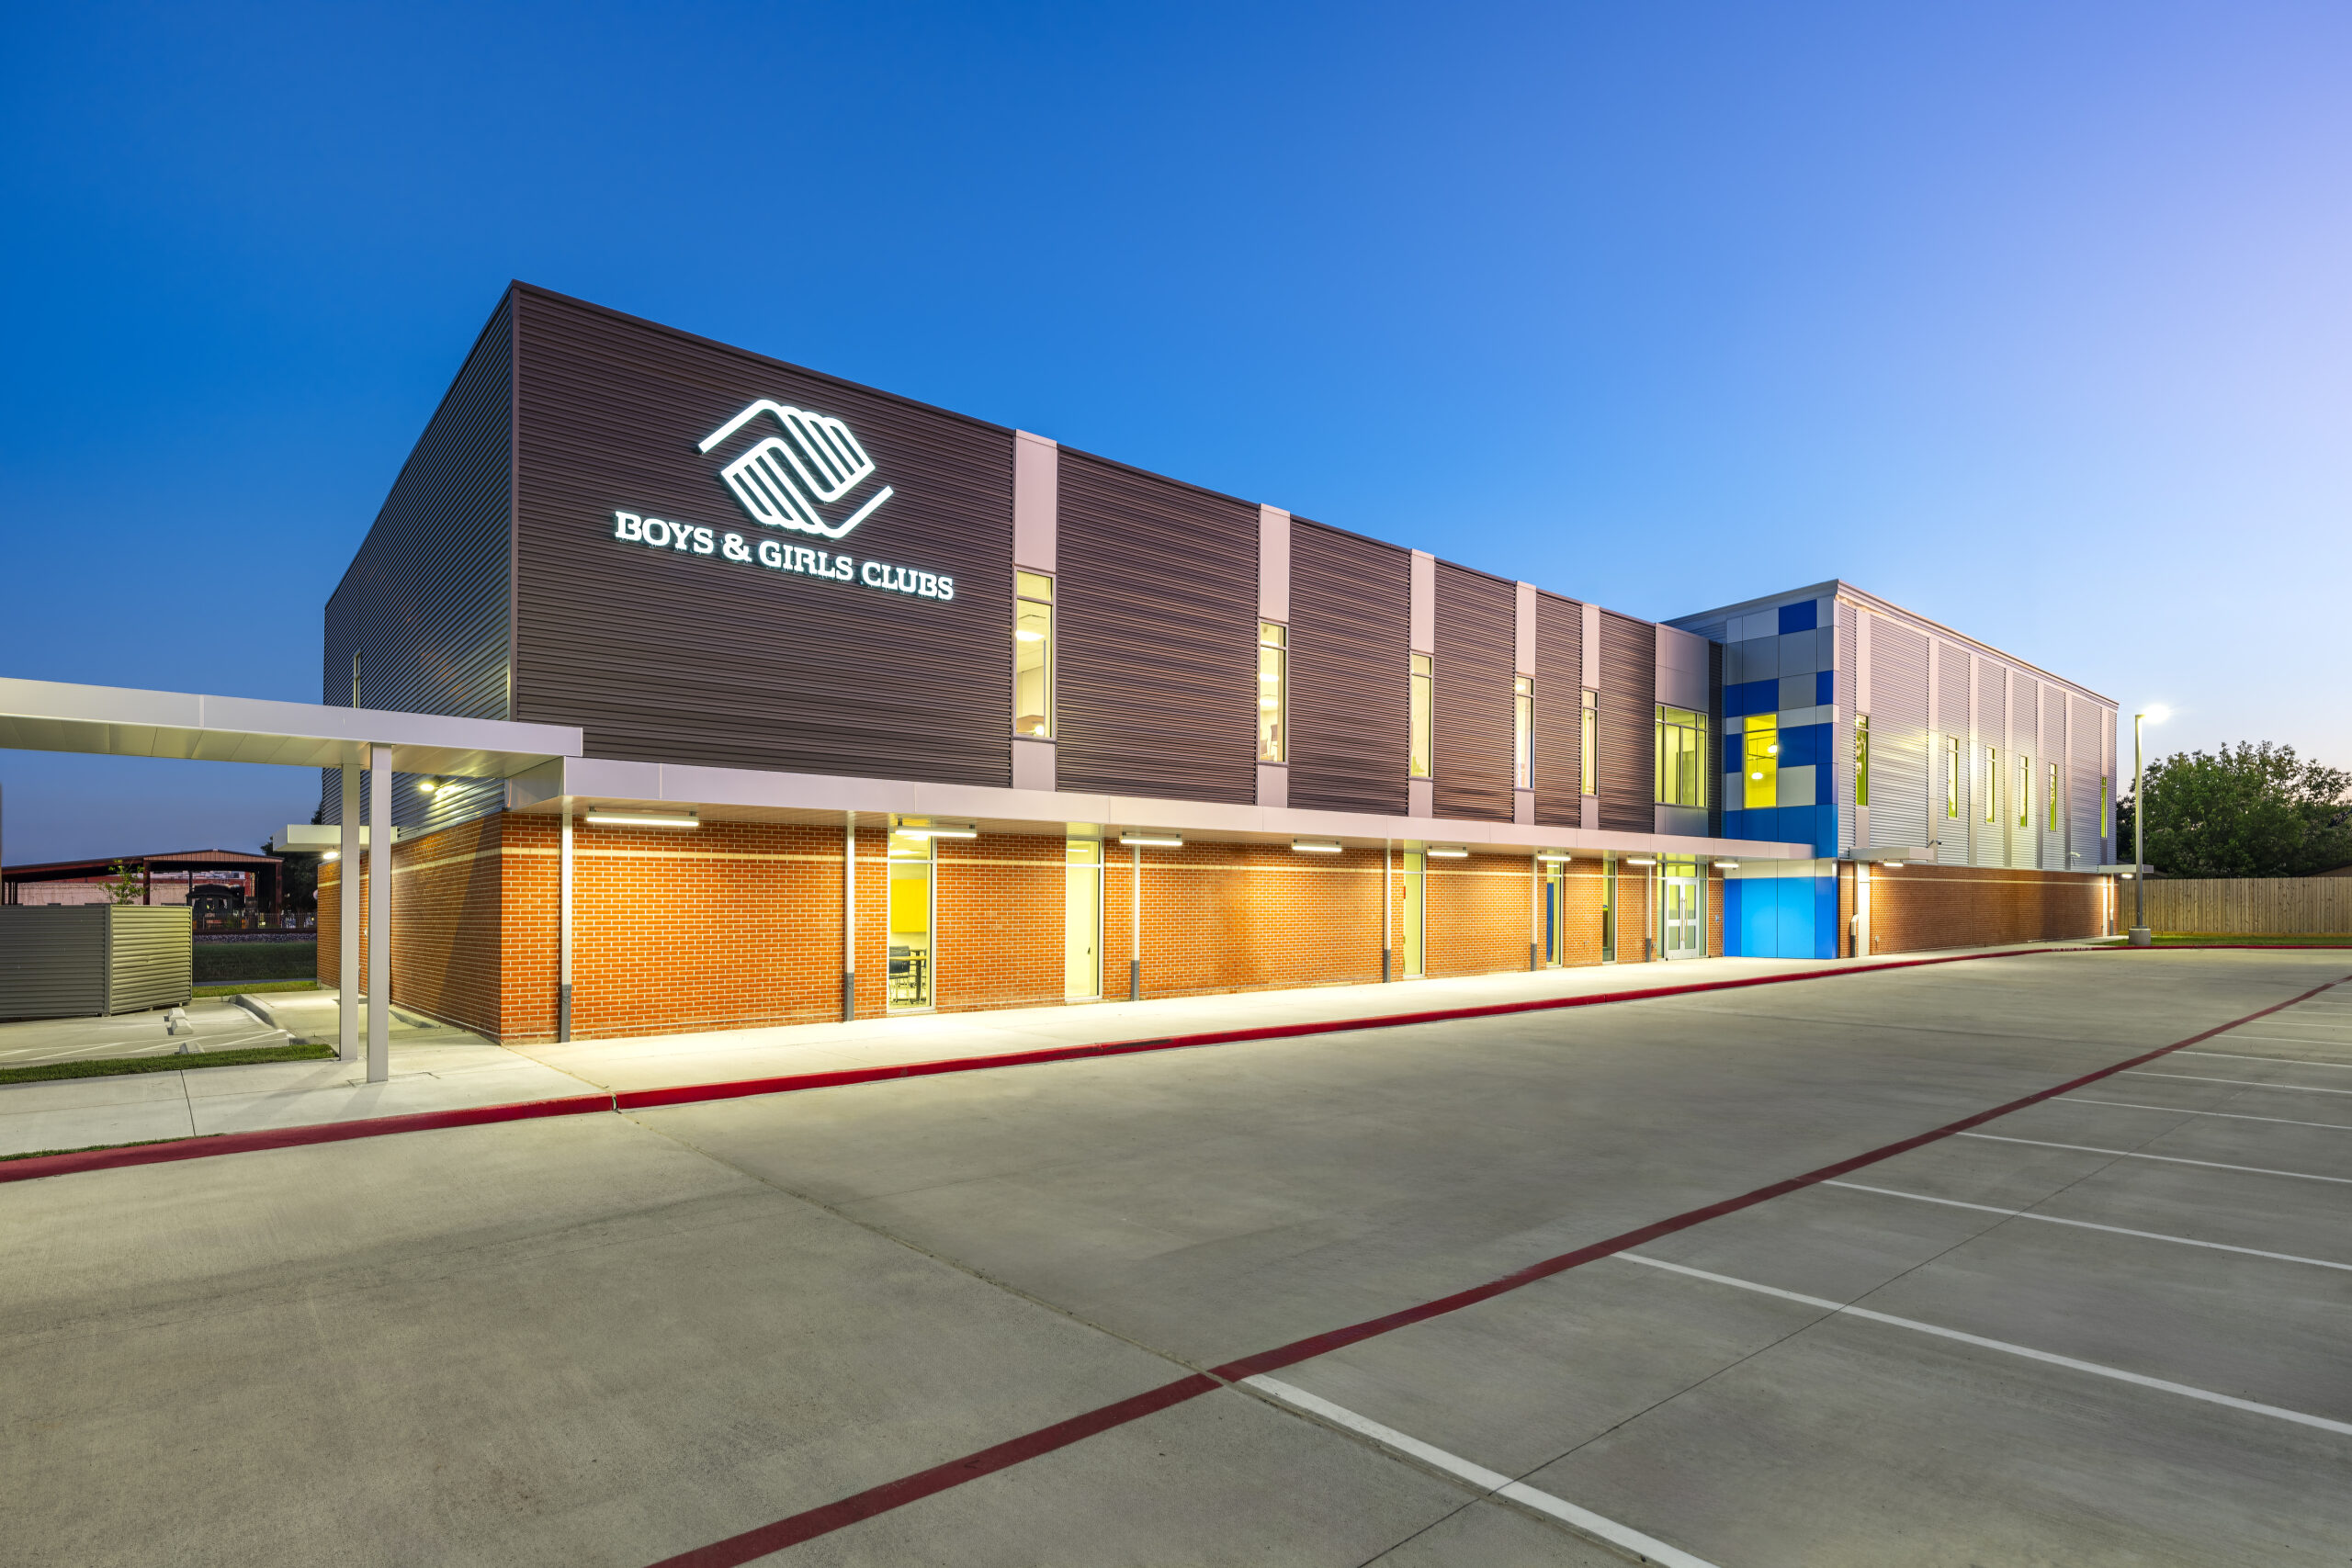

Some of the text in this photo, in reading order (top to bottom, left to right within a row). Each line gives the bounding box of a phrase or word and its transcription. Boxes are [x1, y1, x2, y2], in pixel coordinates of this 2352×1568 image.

[615, 511, 955, 601] BOYS & GIRLS CLUBS
